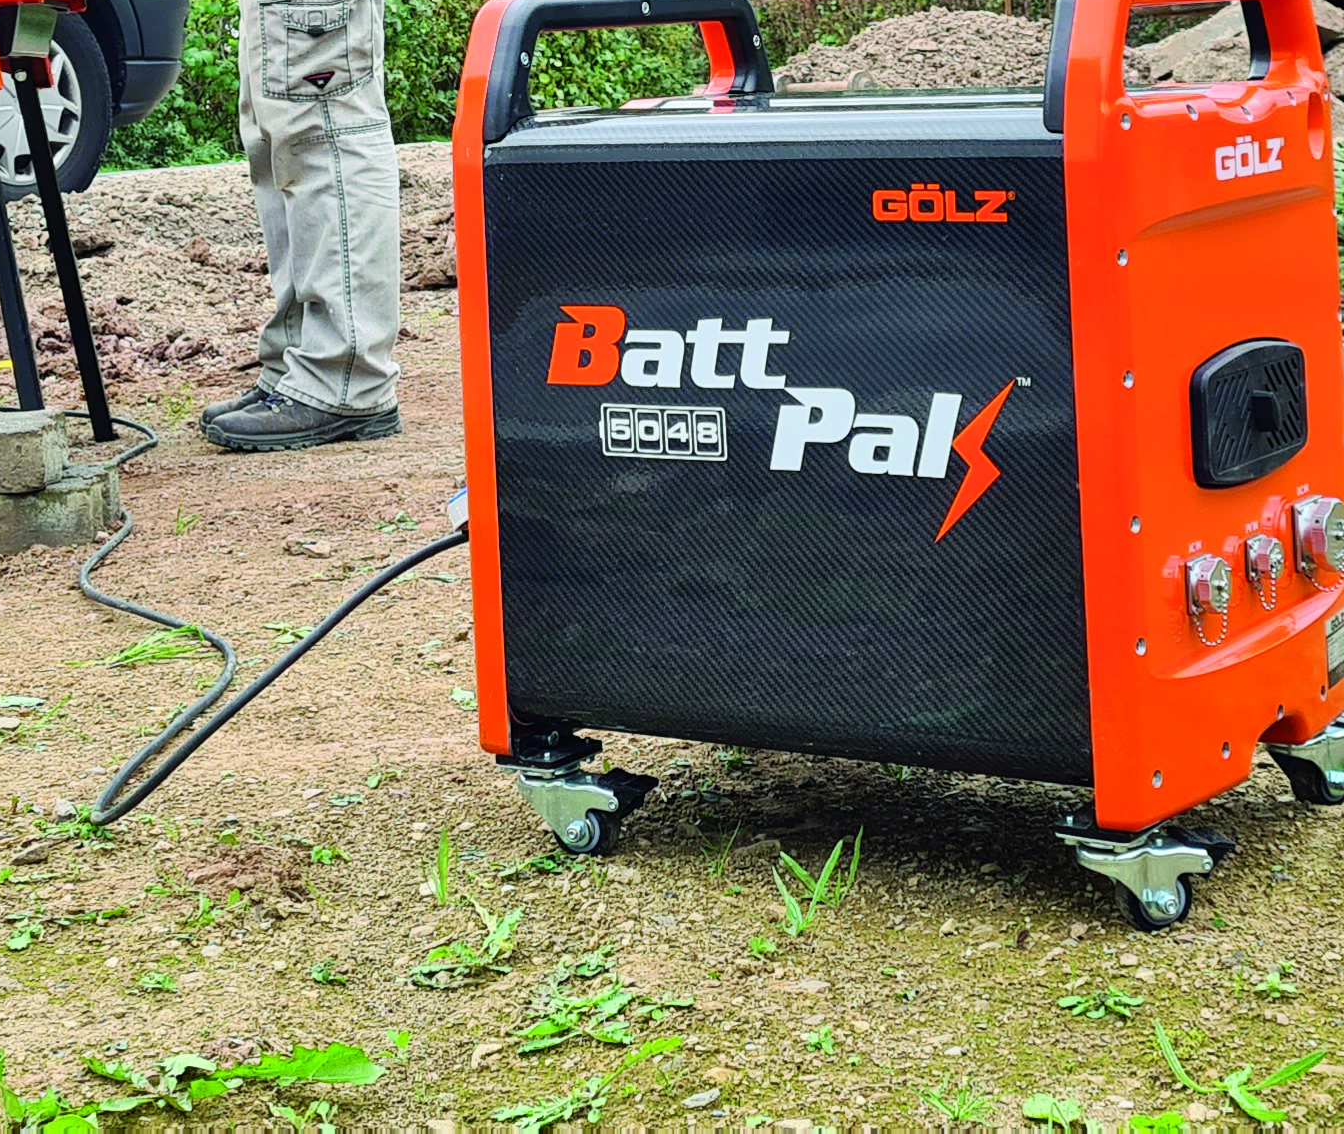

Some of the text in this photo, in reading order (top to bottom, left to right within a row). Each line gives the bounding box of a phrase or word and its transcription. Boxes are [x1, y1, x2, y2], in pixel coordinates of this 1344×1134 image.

[1216, 135, 1285, 181] GÖLZ
[546, 305, 790, 390] Batt
[609, 418, 719, 445] 5048
